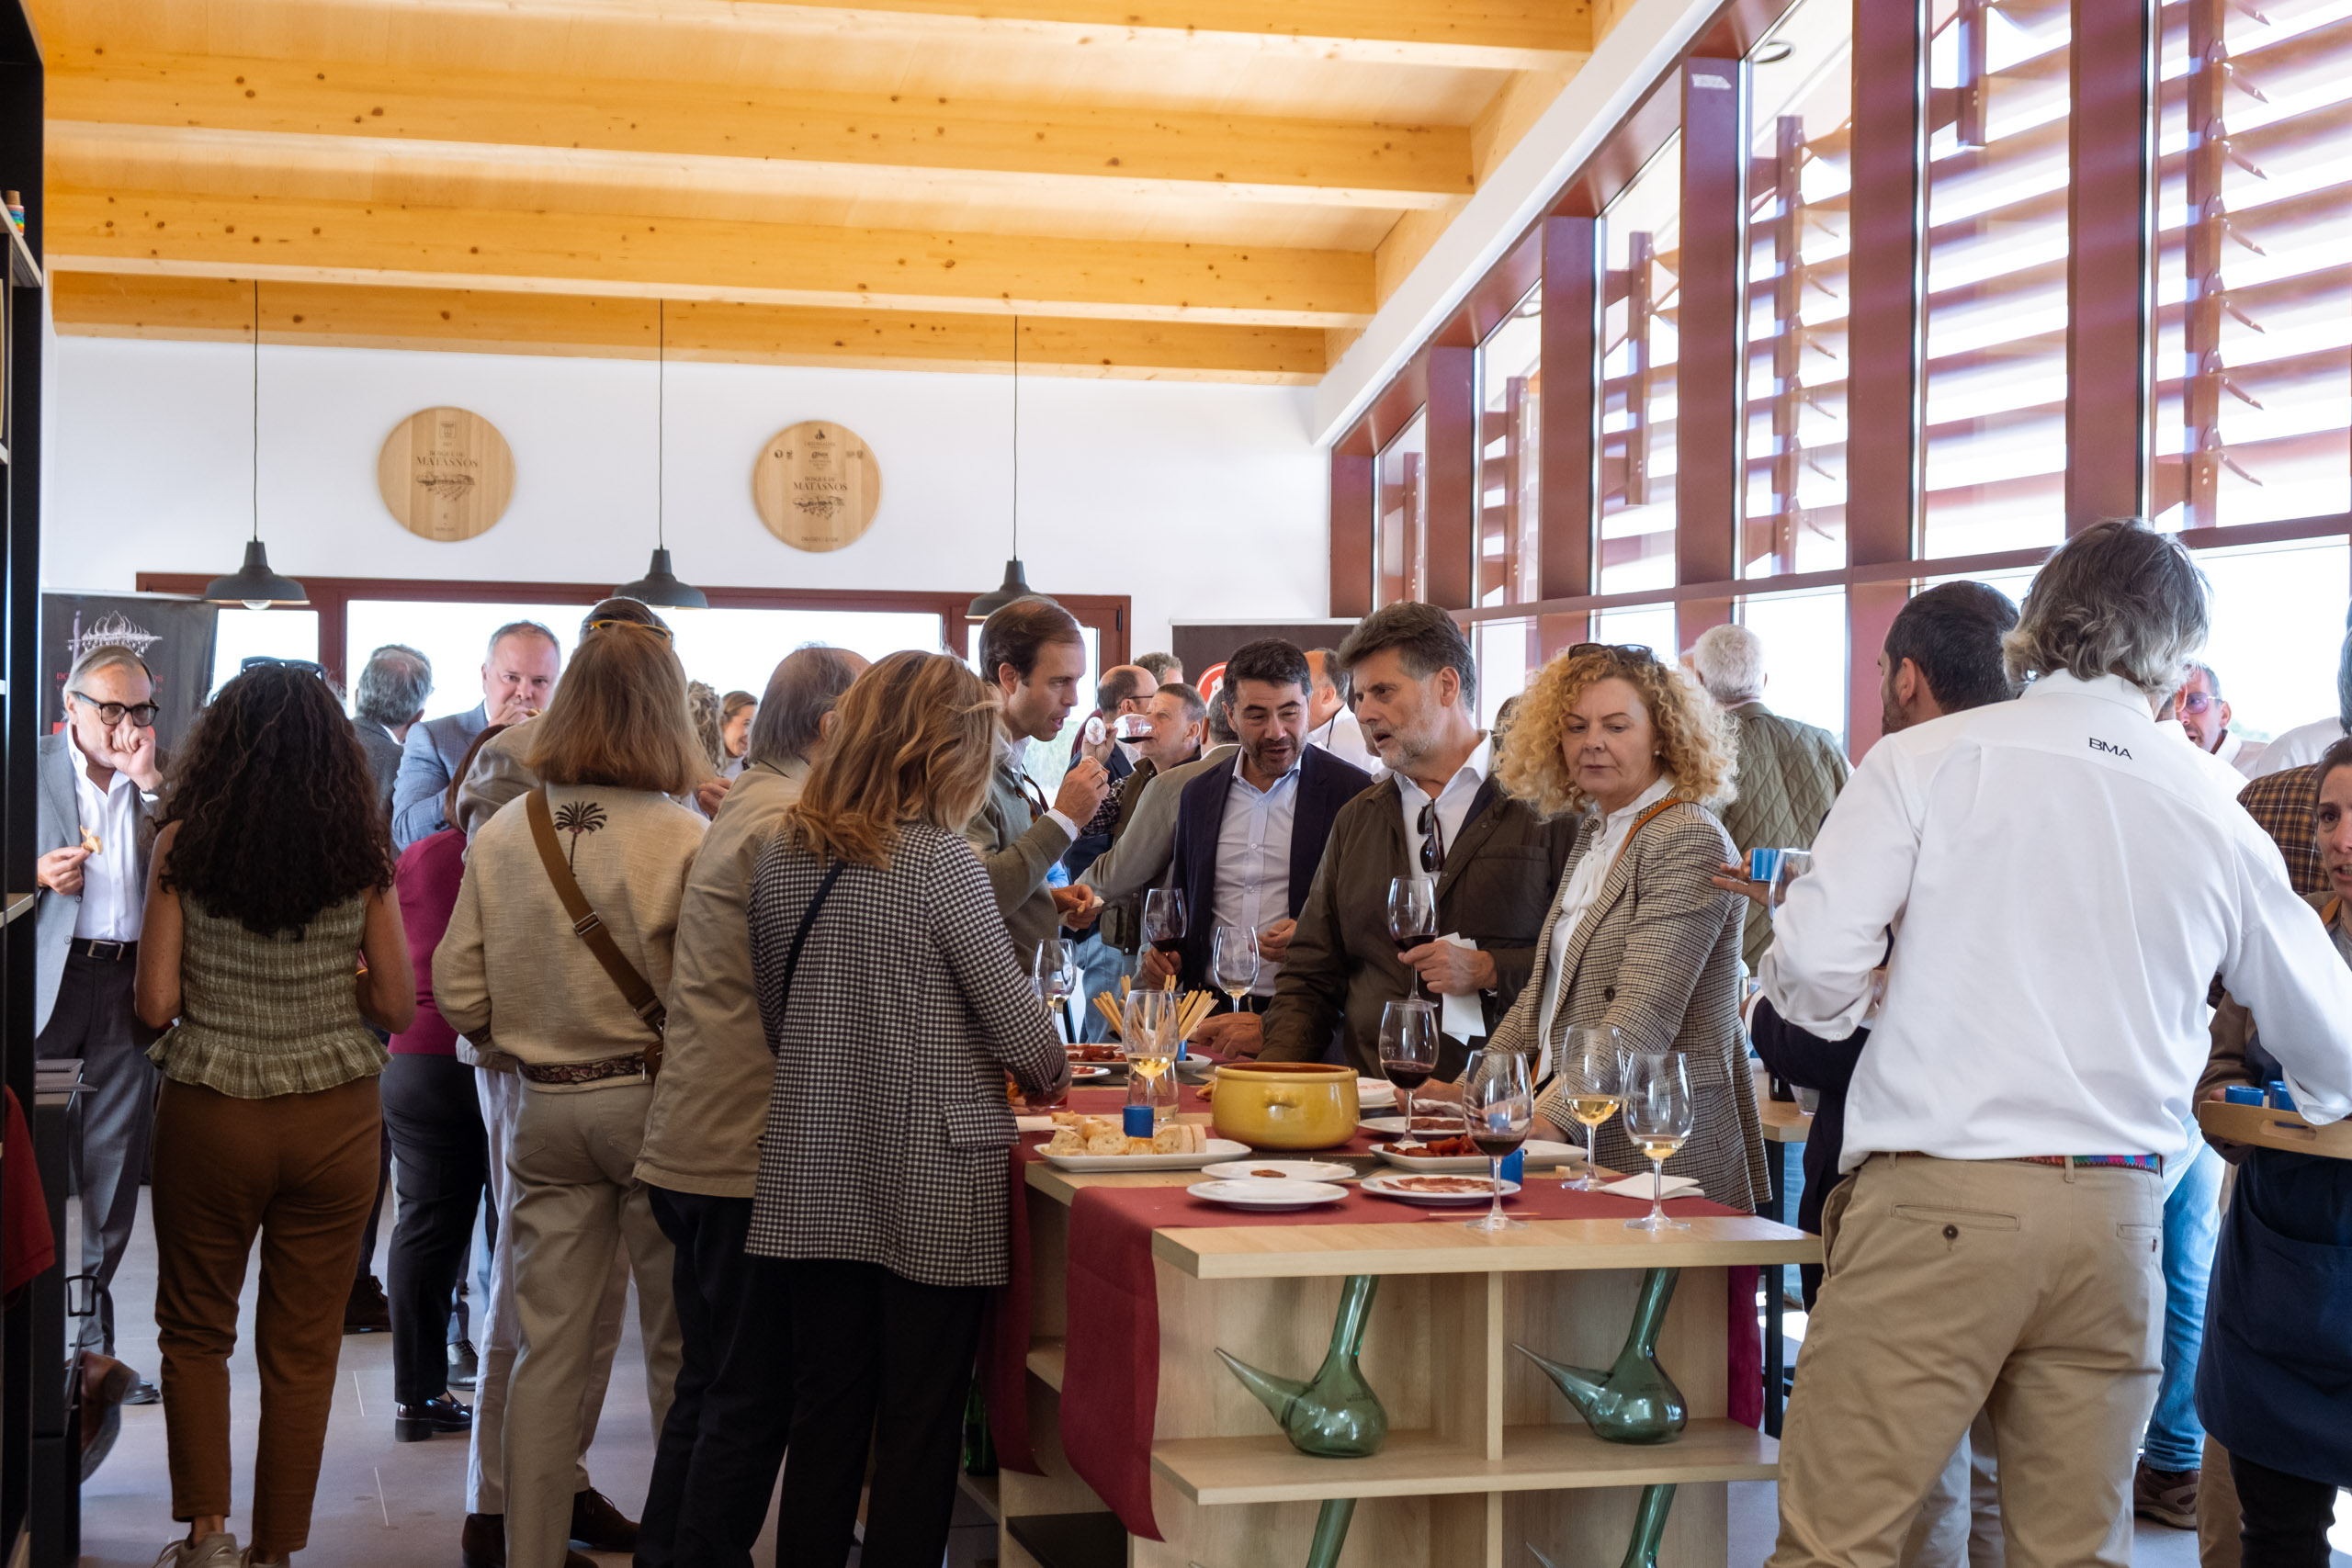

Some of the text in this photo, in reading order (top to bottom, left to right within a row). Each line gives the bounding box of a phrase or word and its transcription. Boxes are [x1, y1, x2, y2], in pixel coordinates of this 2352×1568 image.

[417, 456, 478, 468] MATASNOS
[794, 481, 848, 491] MATASNOS
[2088, 737, 2132, 761] BMA
